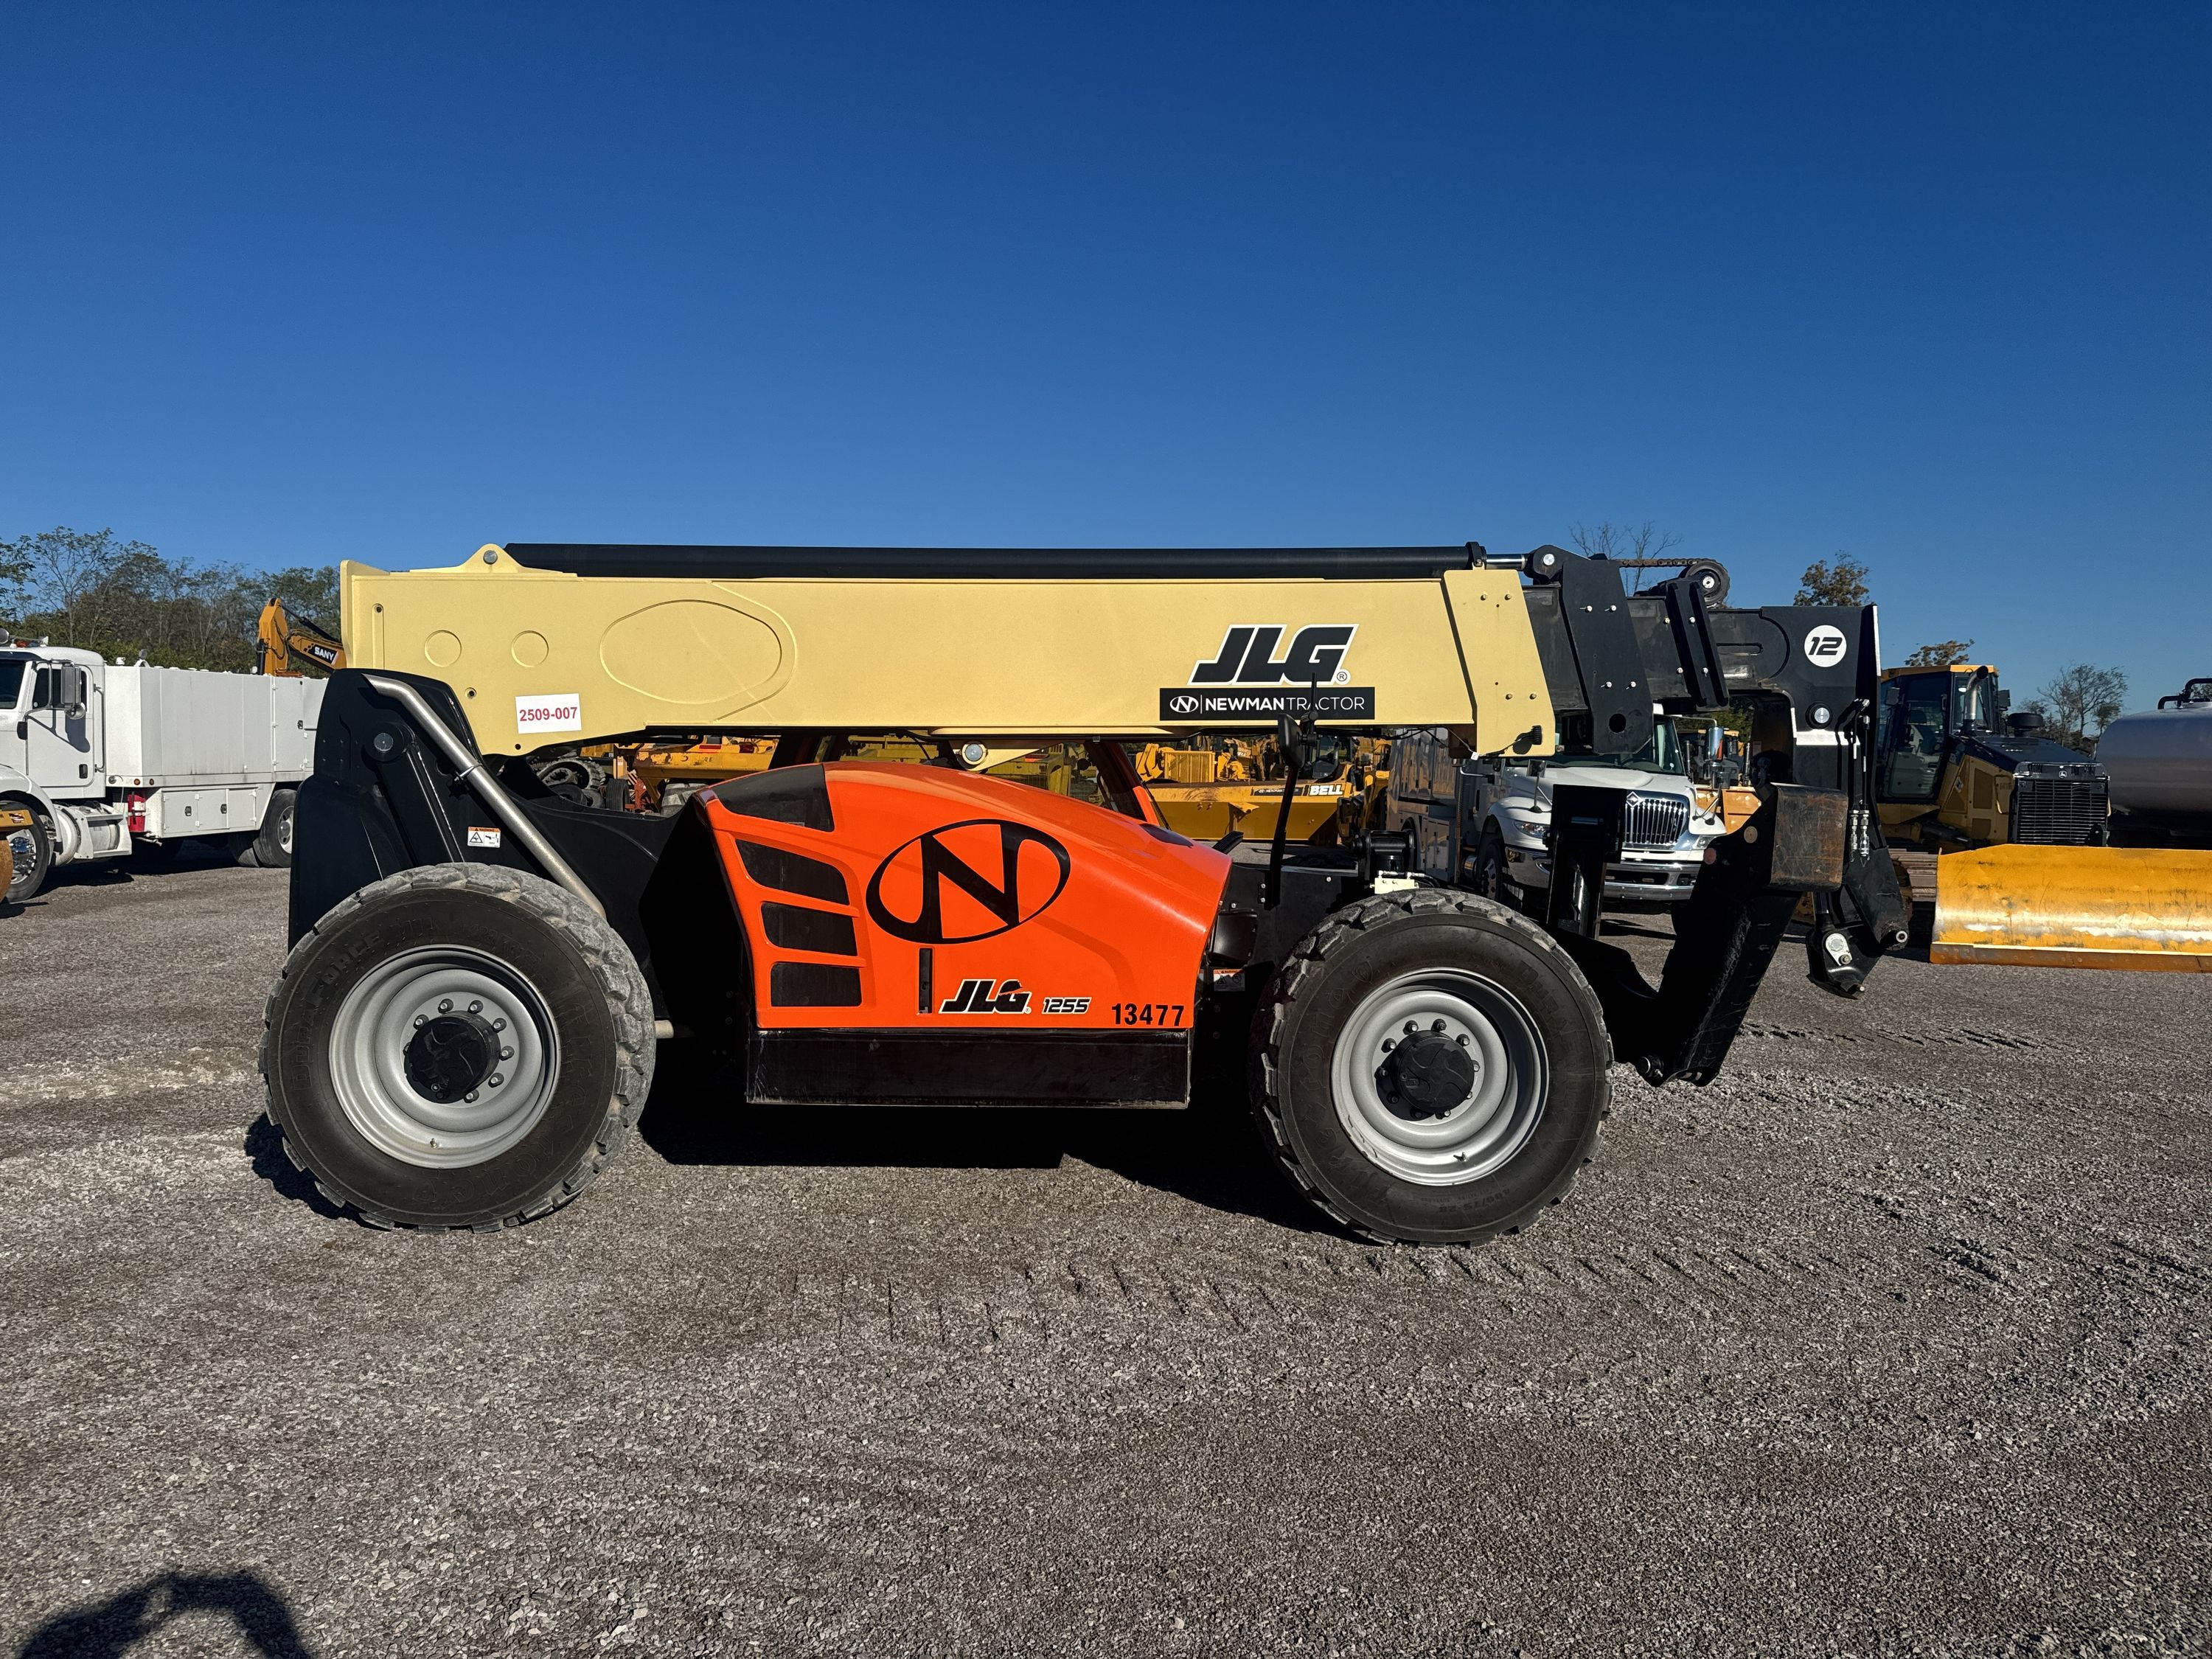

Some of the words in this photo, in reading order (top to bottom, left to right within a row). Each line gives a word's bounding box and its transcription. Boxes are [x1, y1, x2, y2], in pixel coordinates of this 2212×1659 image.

[314, 646, 334, 661] SANY
[1808, 636, 1843, 655] 12
[1189, 625, 1357, 684] JLG
[519, 706, 578, 722] 2509-007
[1310, 785, 1343, 796] BELL
[939, 979, 1032, 1014] JLG
[1042, 997, 1091, 1014] 1255
[1111, 1003, 1184, 1026] 13477
